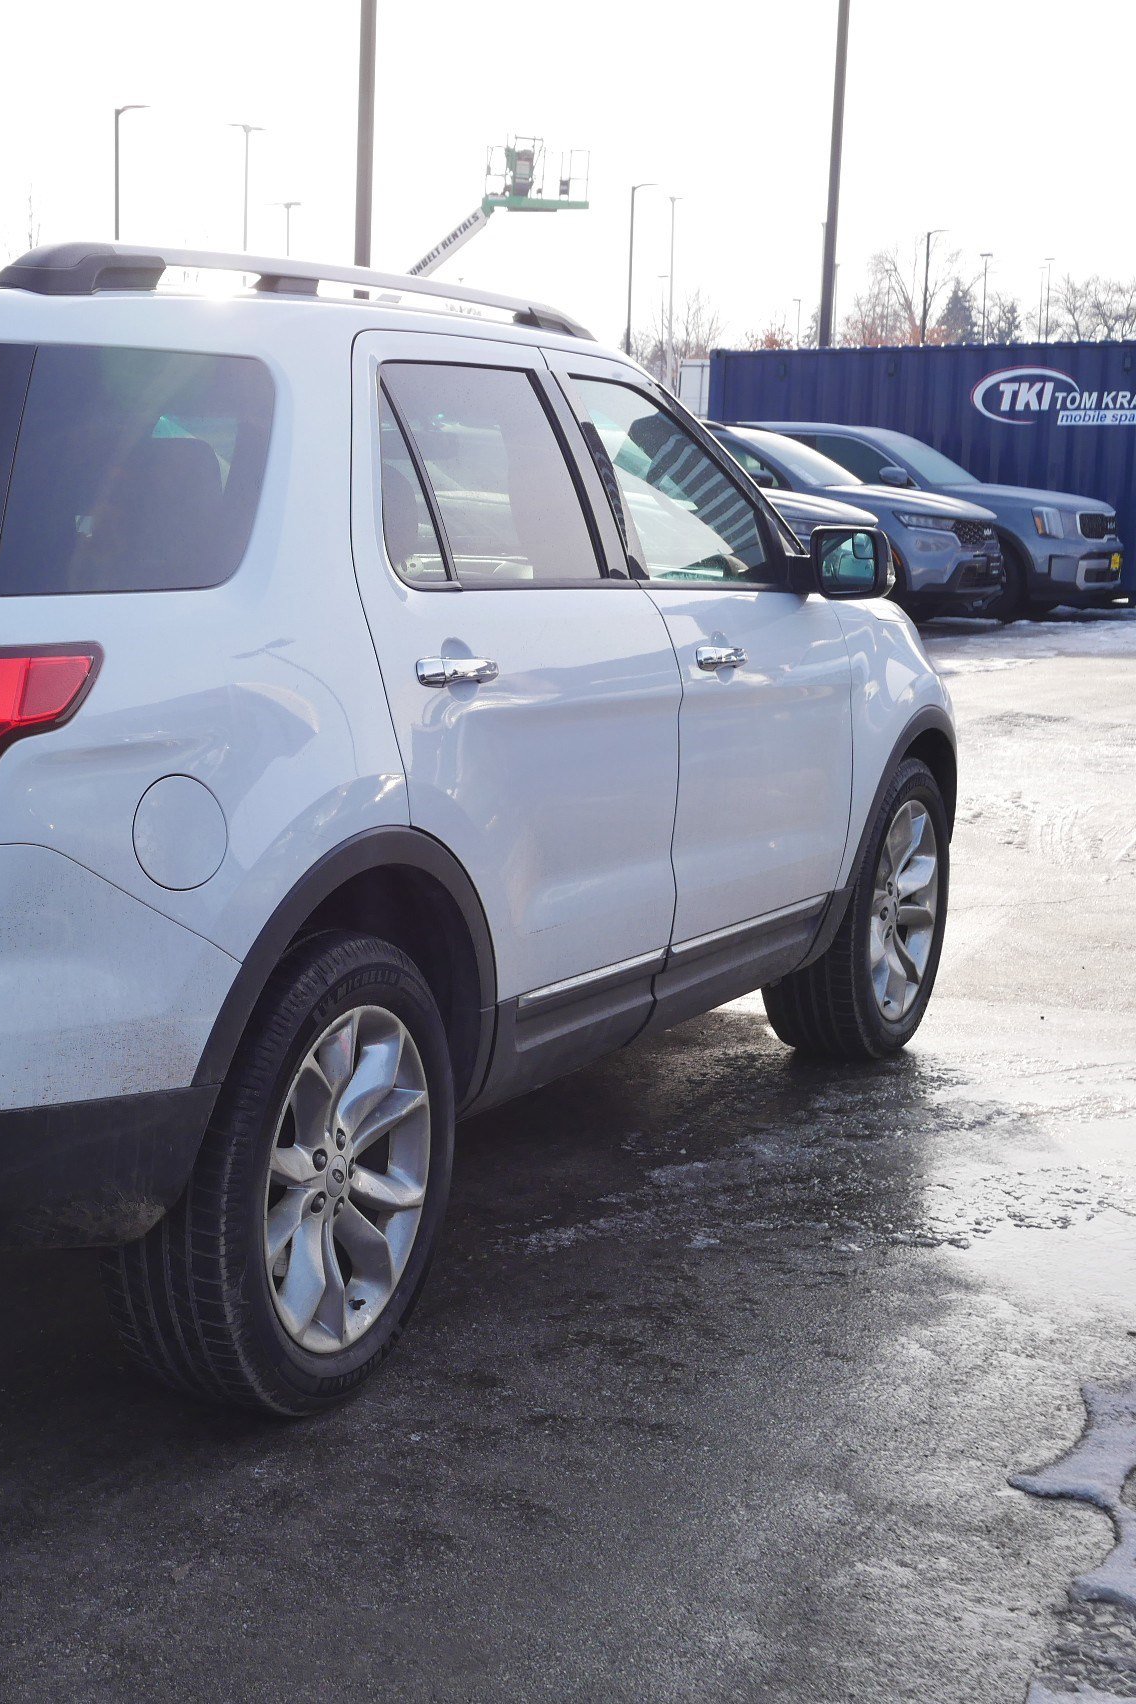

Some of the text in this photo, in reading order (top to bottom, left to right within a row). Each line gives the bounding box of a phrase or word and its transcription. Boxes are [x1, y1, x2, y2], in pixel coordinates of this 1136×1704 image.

[407, 211, 480, 276] UNBELT RENTALS
[999, 381, 1054, 411] TKI
[1055, 391, 1098, 409] TOM
[1060, 411, 1136, 425] mobile spa
